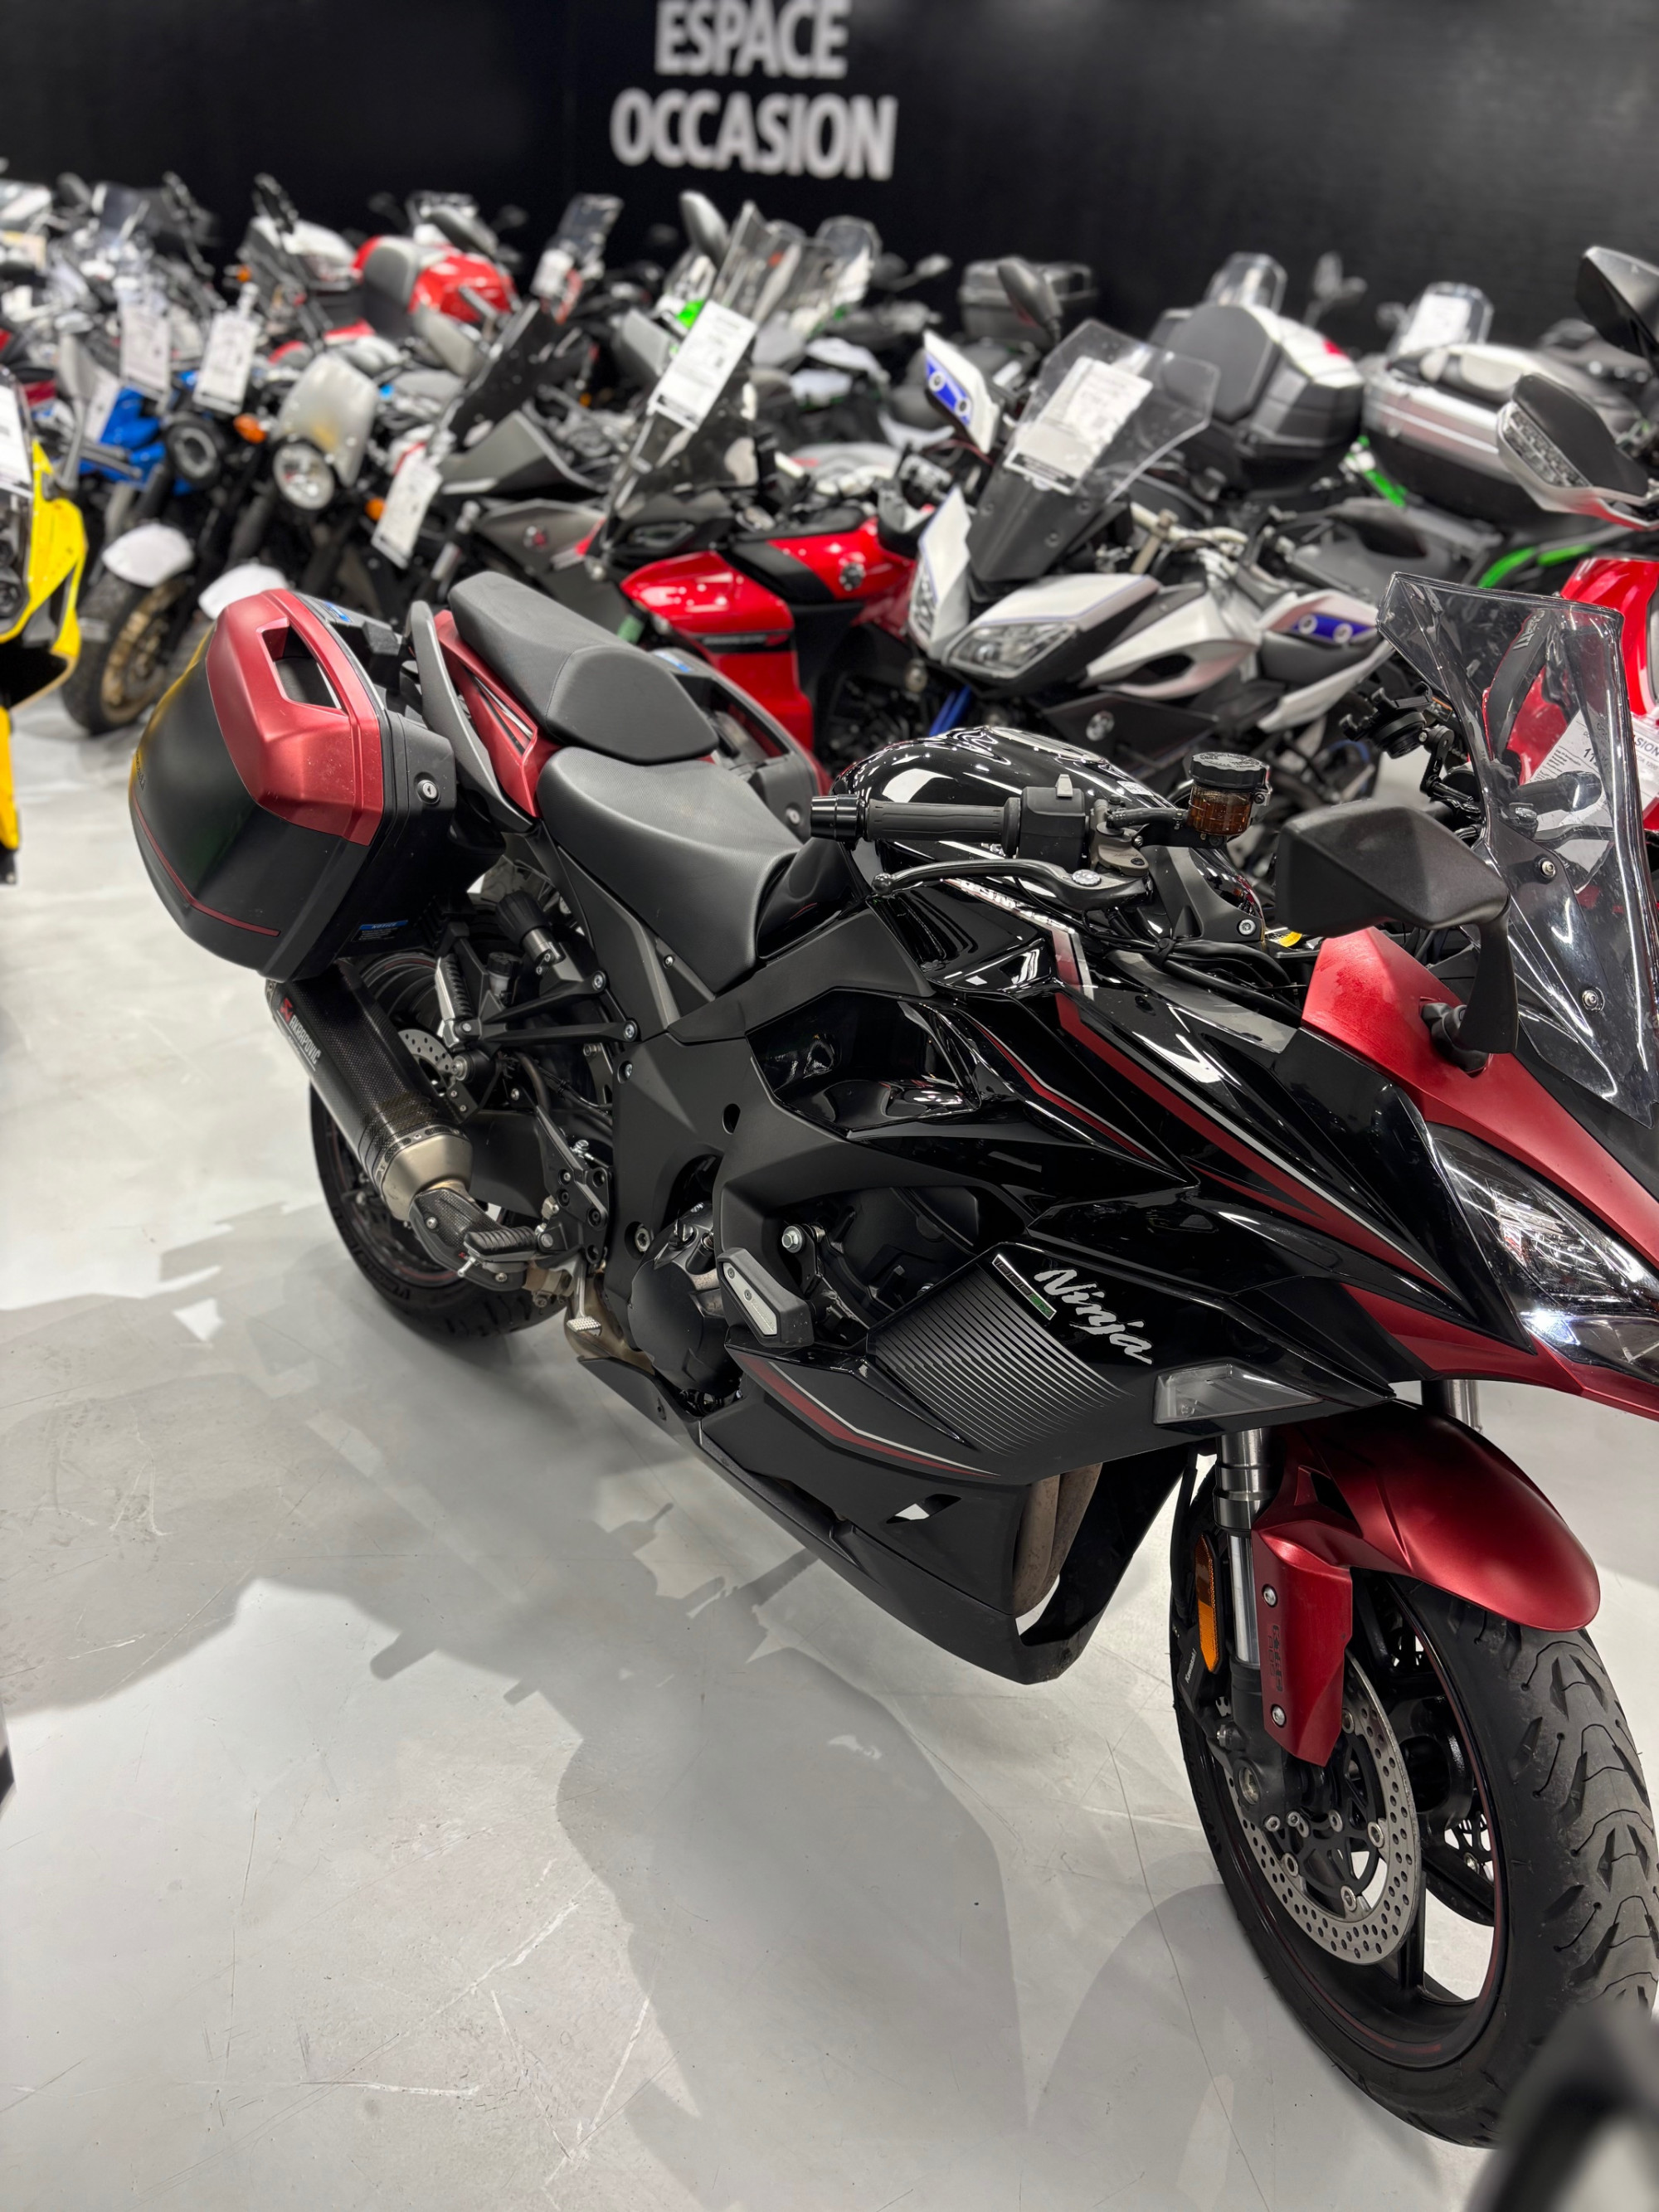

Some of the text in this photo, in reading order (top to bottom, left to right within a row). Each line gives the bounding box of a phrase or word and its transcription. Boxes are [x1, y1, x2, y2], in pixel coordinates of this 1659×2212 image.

[654, 0, 851, 79] ESPACE
[610, 88, 898, 181] OCCASION
[1034, 1269, 1153, 1364] Ninja
[1184, 1646, 1197, 1684] Kawasaki
